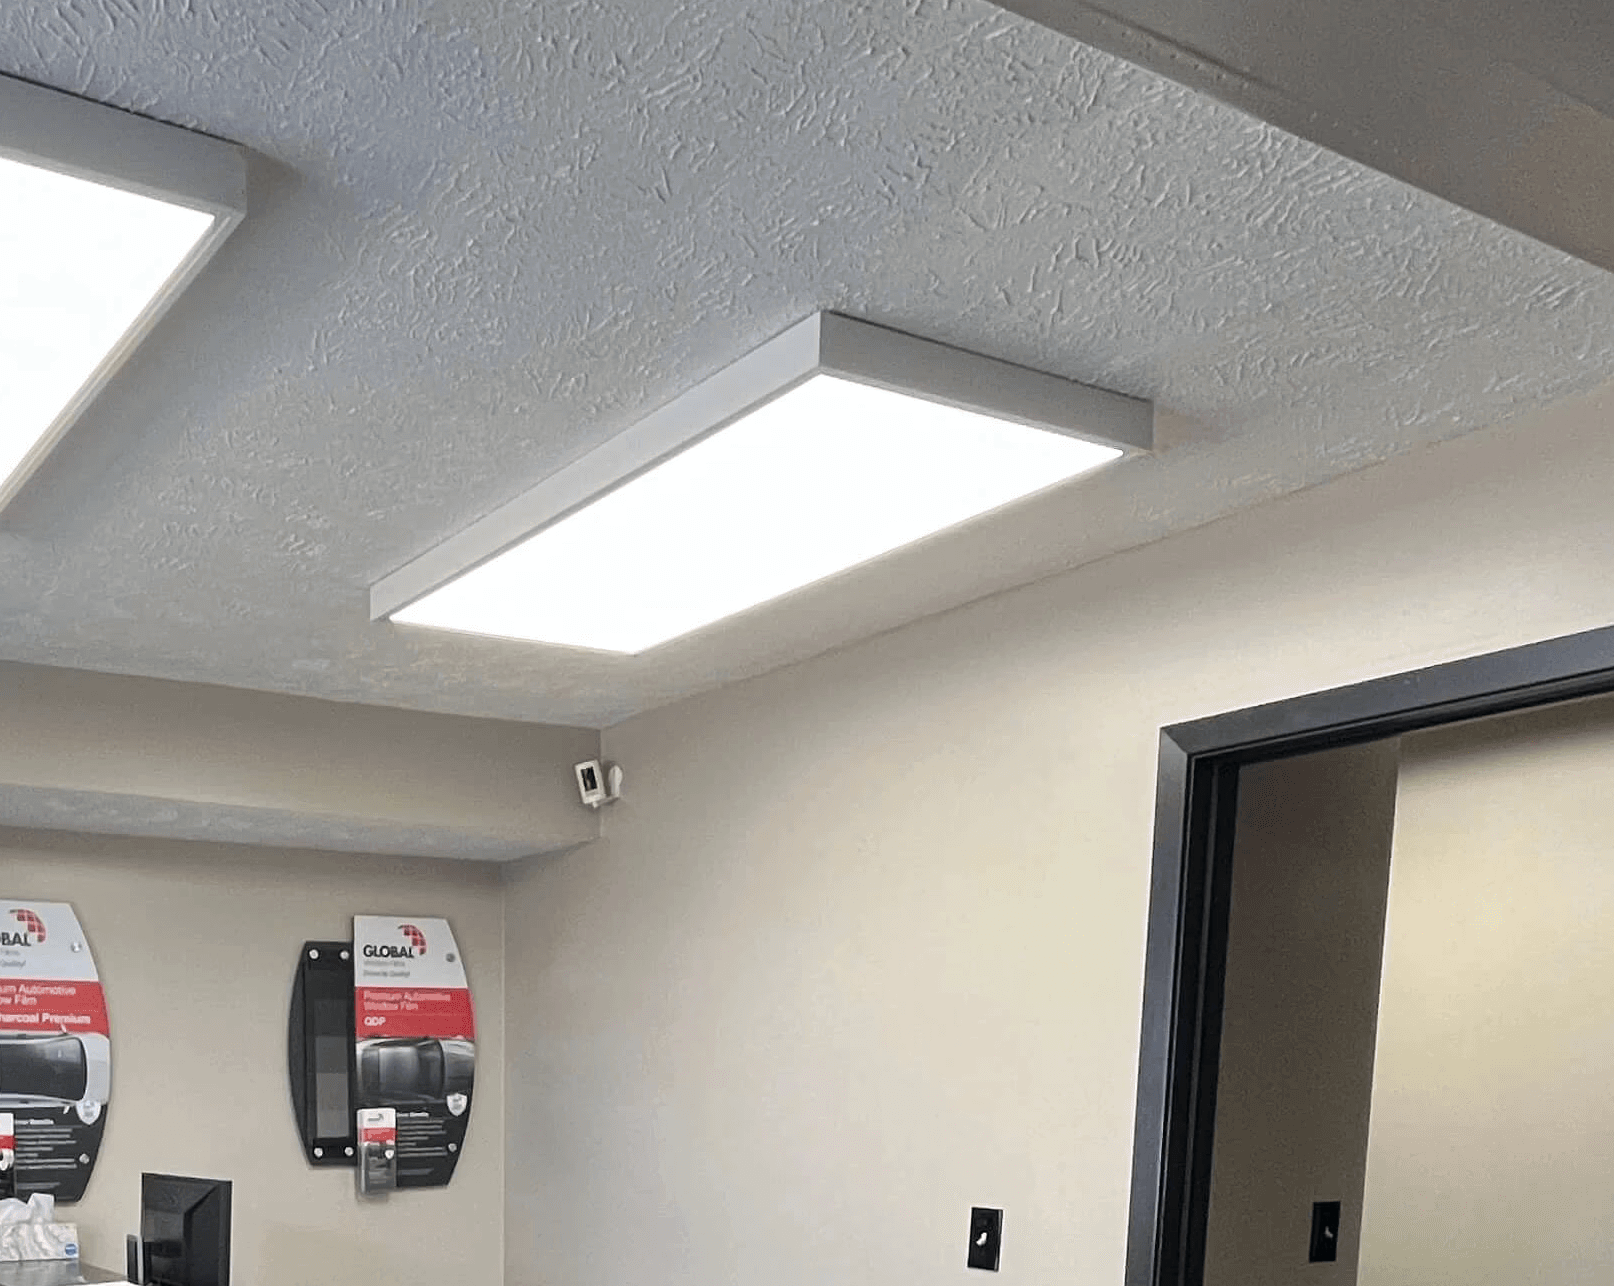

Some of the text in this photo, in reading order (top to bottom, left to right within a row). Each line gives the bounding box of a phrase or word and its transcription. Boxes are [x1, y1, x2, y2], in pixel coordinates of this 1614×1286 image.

[363, 944, 415, 958] GLOBAL
[42, 1012, 91, 1024] Premium
[364, 1016, 386, 1026] QDP
